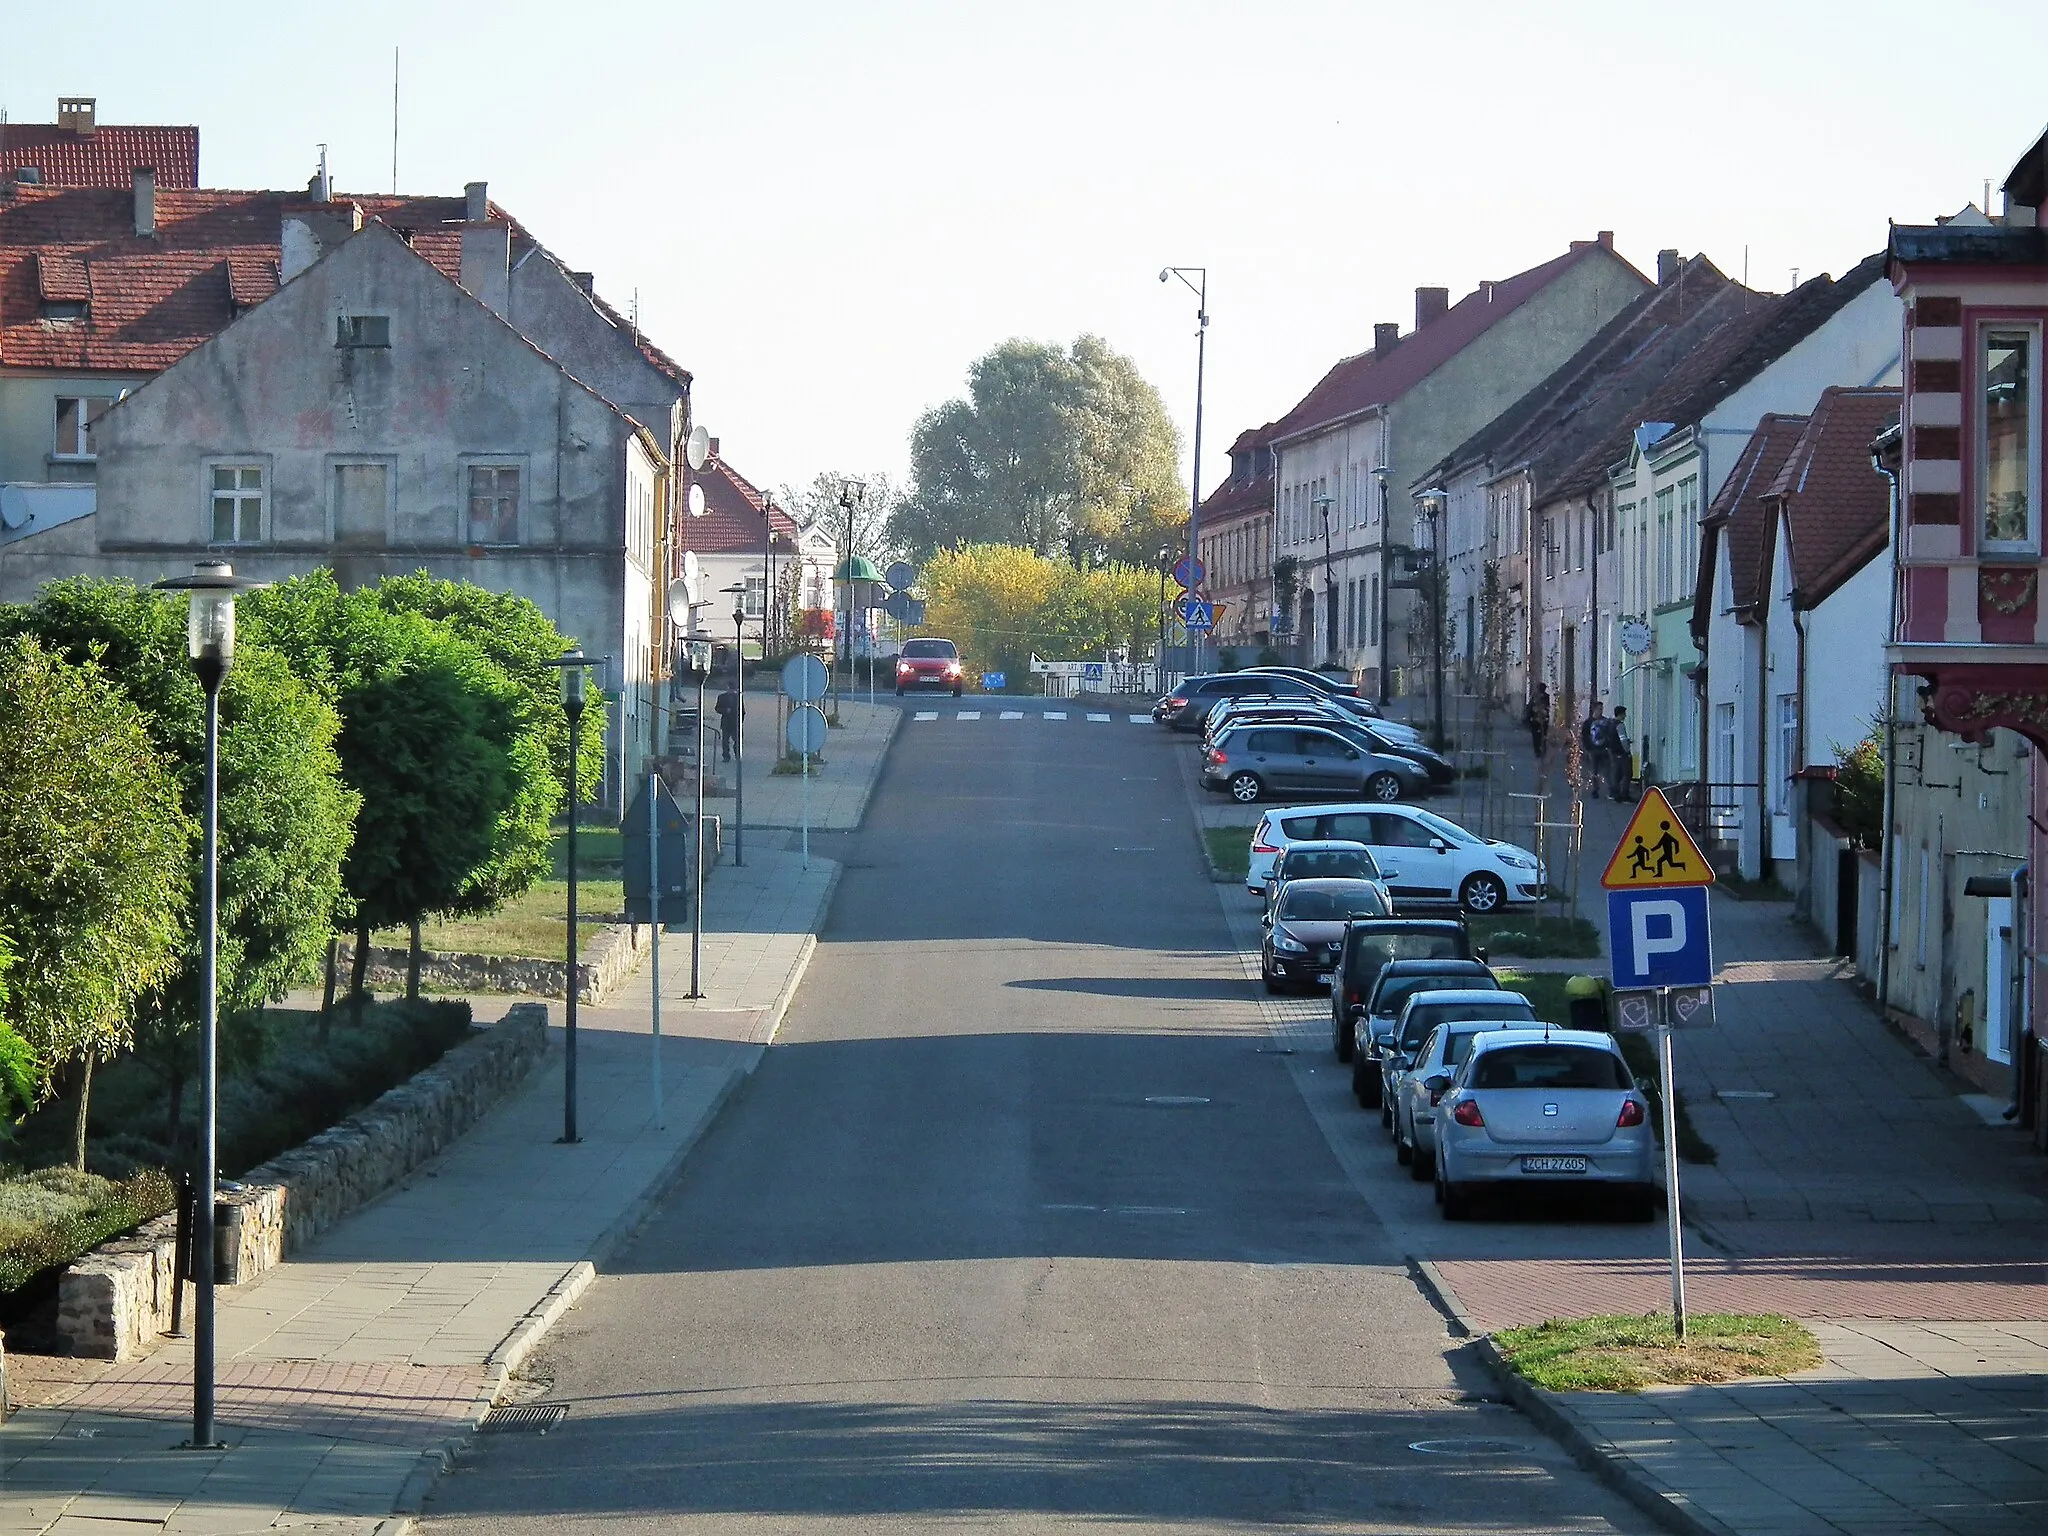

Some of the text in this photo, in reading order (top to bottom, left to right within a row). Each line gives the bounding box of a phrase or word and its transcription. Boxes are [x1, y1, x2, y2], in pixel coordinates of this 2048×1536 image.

[1631, 900, 1687, 976] P
[1528, 1158, 1585, 1169] ZCH 27605
